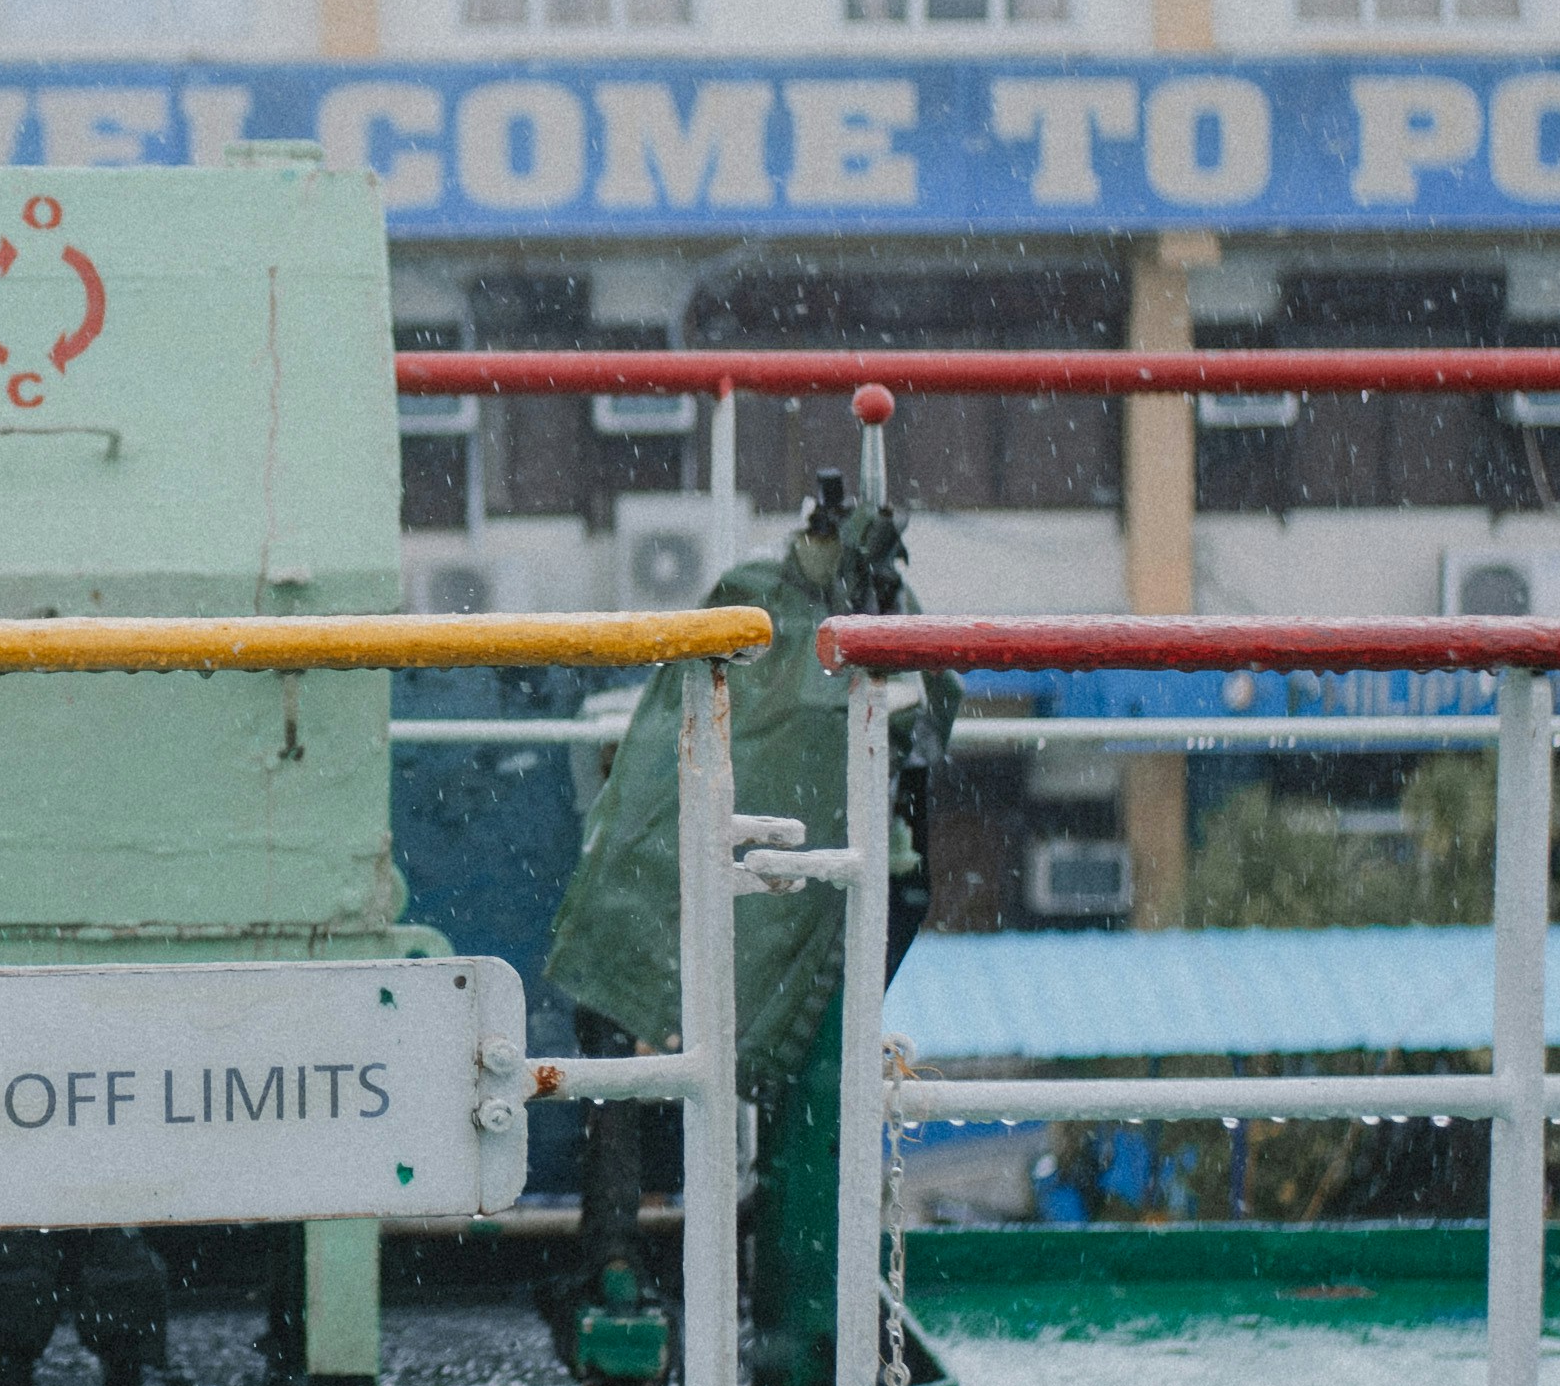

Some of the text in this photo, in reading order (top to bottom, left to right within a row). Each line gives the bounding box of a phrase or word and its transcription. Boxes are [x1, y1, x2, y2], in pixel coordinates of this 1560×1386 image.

[991, 75, 1273, 208] TO
[6, 372, 45, 408] C
[4, 1061, 391, 1129] OFF LIMITS
